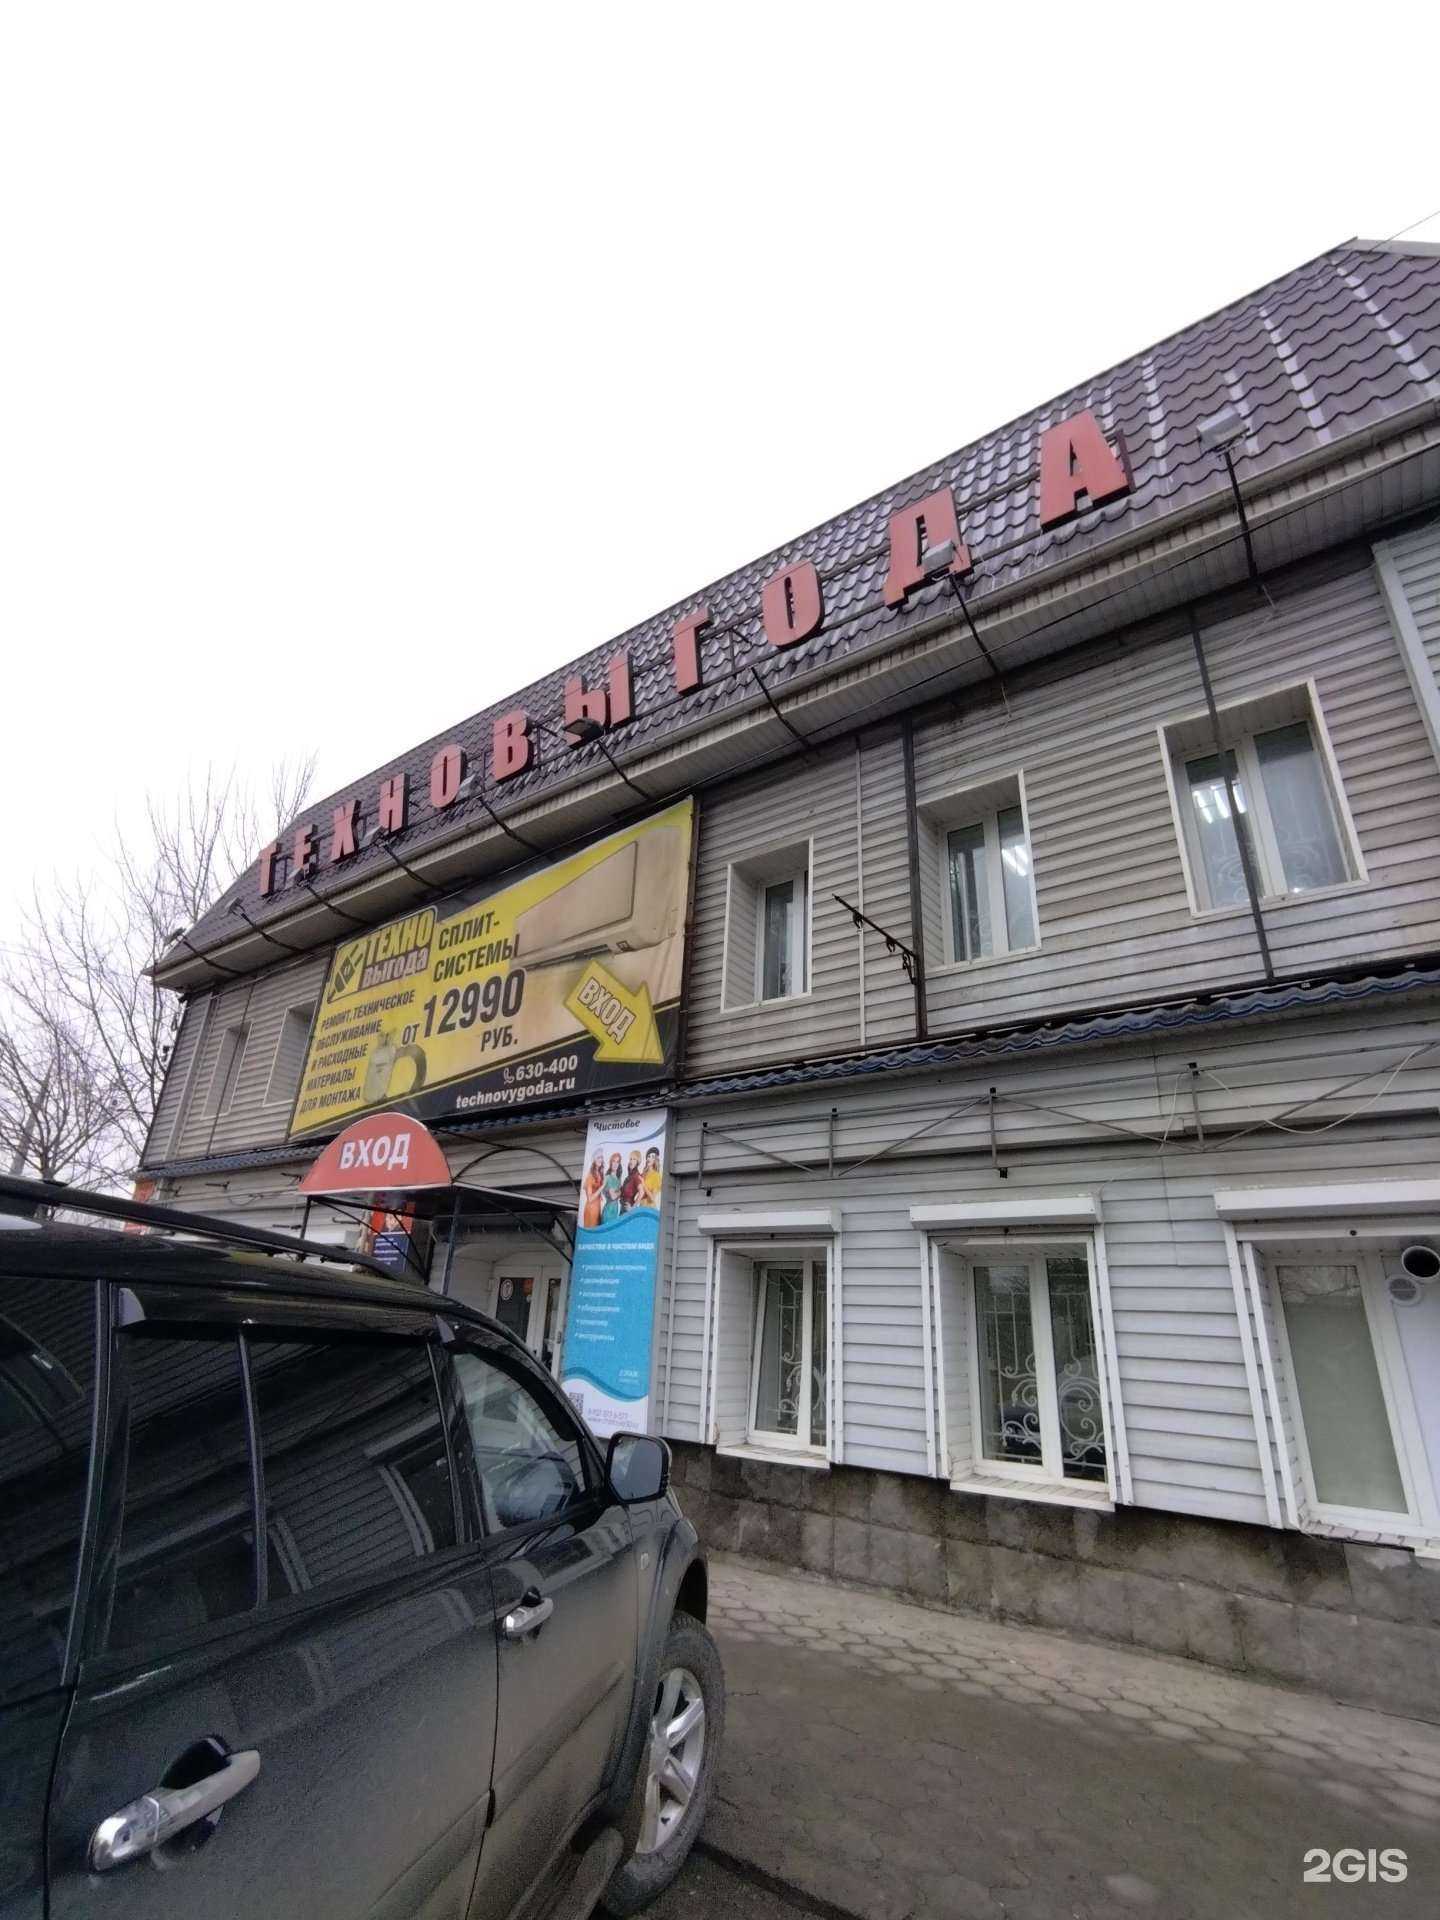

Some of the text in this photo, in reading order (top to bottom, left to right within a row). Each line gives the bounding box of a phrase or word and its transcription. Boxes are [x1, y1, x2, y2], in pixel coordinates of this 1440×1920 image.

[365, 909, 434, 966] ТЕХНО
[438, 910, 500, 950] СПЛИТ-
[432, 933, 520, 983] СИСТЕМЫ
[353, 990, 415, 1020] ТЕХНИЧЕСКОЕ
[401, 968, 526, 1045] ОТ 12990
[577, 976, 637, 1046] ВХОД
[315, 1019, 382, 1052] ОБСЛУЖИВАНИЕ
[480, 1025, 518, 1052] РУБ.
[317, 1043, 368, 1069] РАСХОДНЫЕ
[515, 1054, 578, 1082] 630-400
[306, 1066, 357, 1090] МАТЕРИАЛЫ
[456, 1076, 576, 1109] technovygoda.ru
[318, 1086, 361, 1109] МОНТАЖА
[593, 1119, 641, 1132] Чистовье
[339, 1133, 411, 1171] ВХОД
